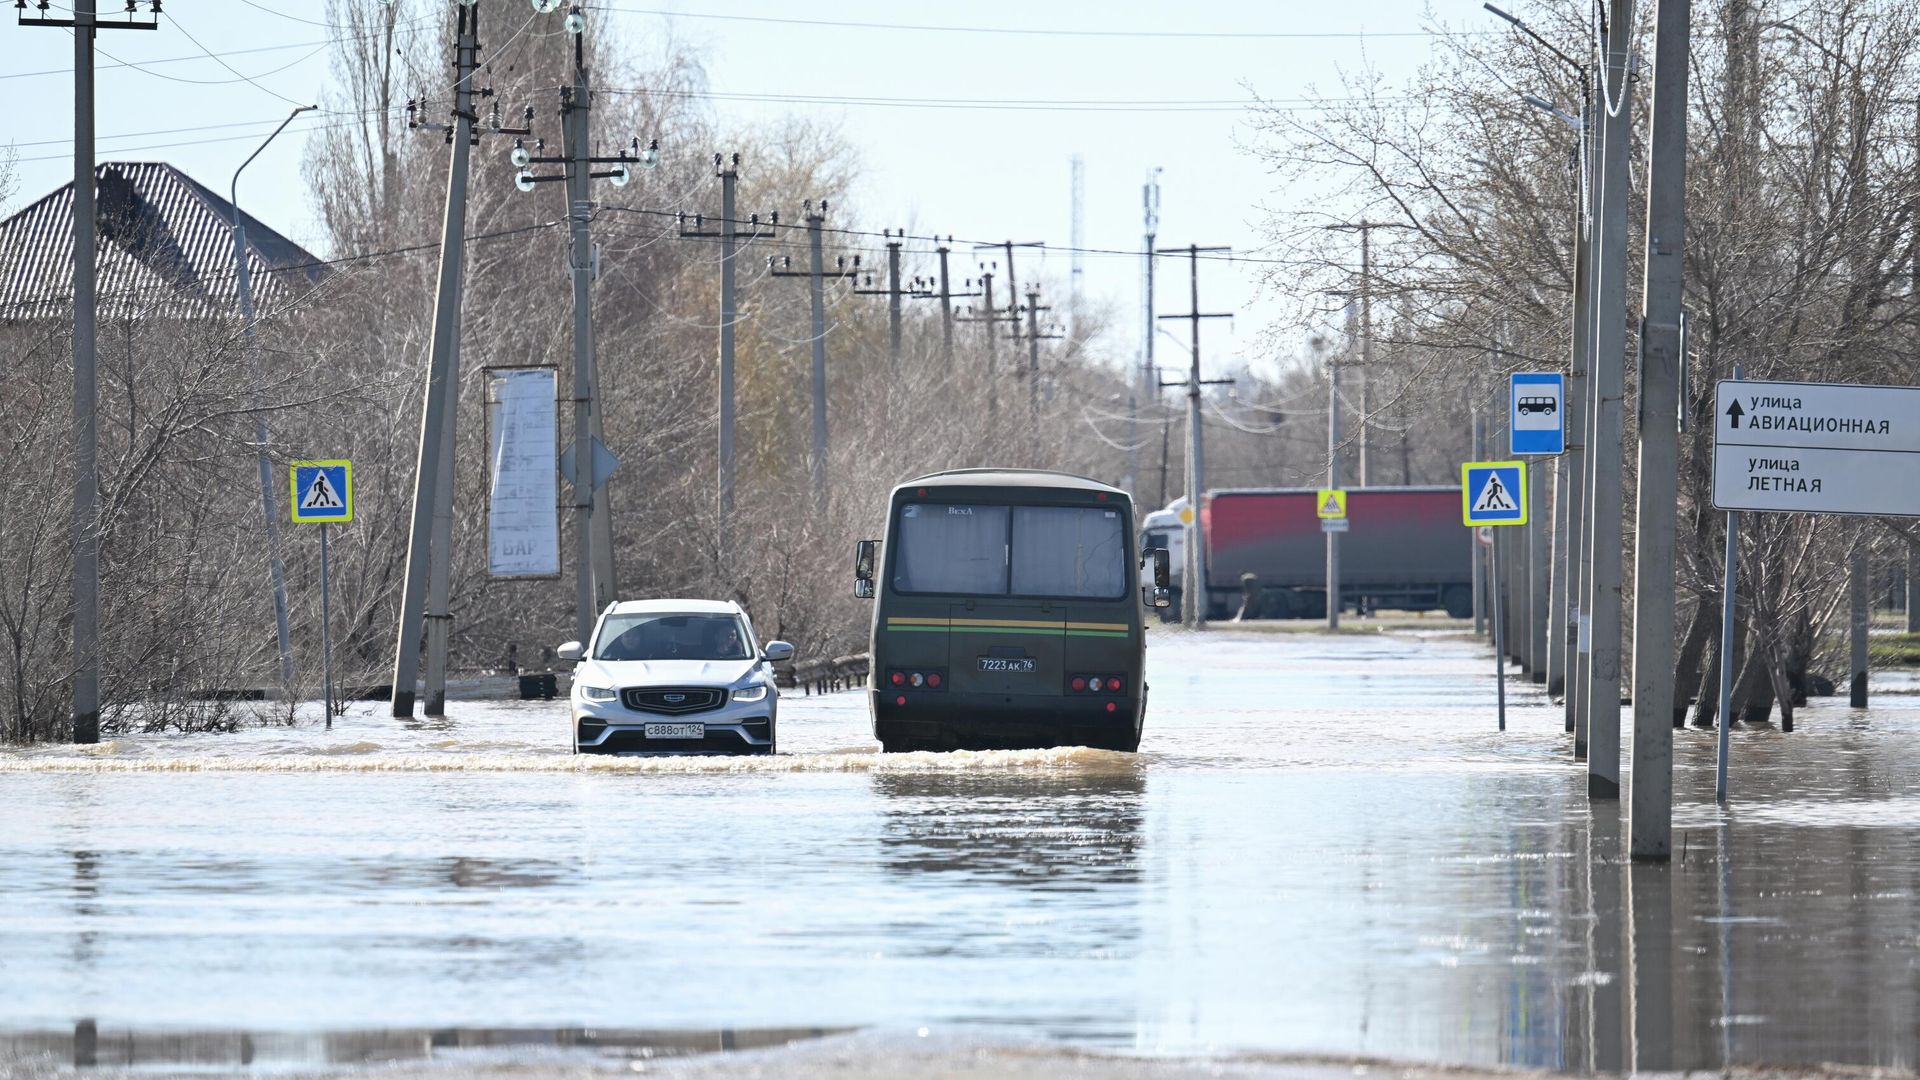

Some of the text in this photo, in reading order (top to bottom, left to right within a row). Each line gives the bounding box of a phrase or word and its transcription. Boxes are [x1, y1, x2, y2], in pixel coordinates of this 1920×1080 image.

[1750, 396, 1802, 411] улица
[1749, 415, 1890, 435] АВИАЦИОННАЯ
[1748, 457, 1800, 472] улица
[1748, 476, 1822, 493] ЛЕТНАЯ
